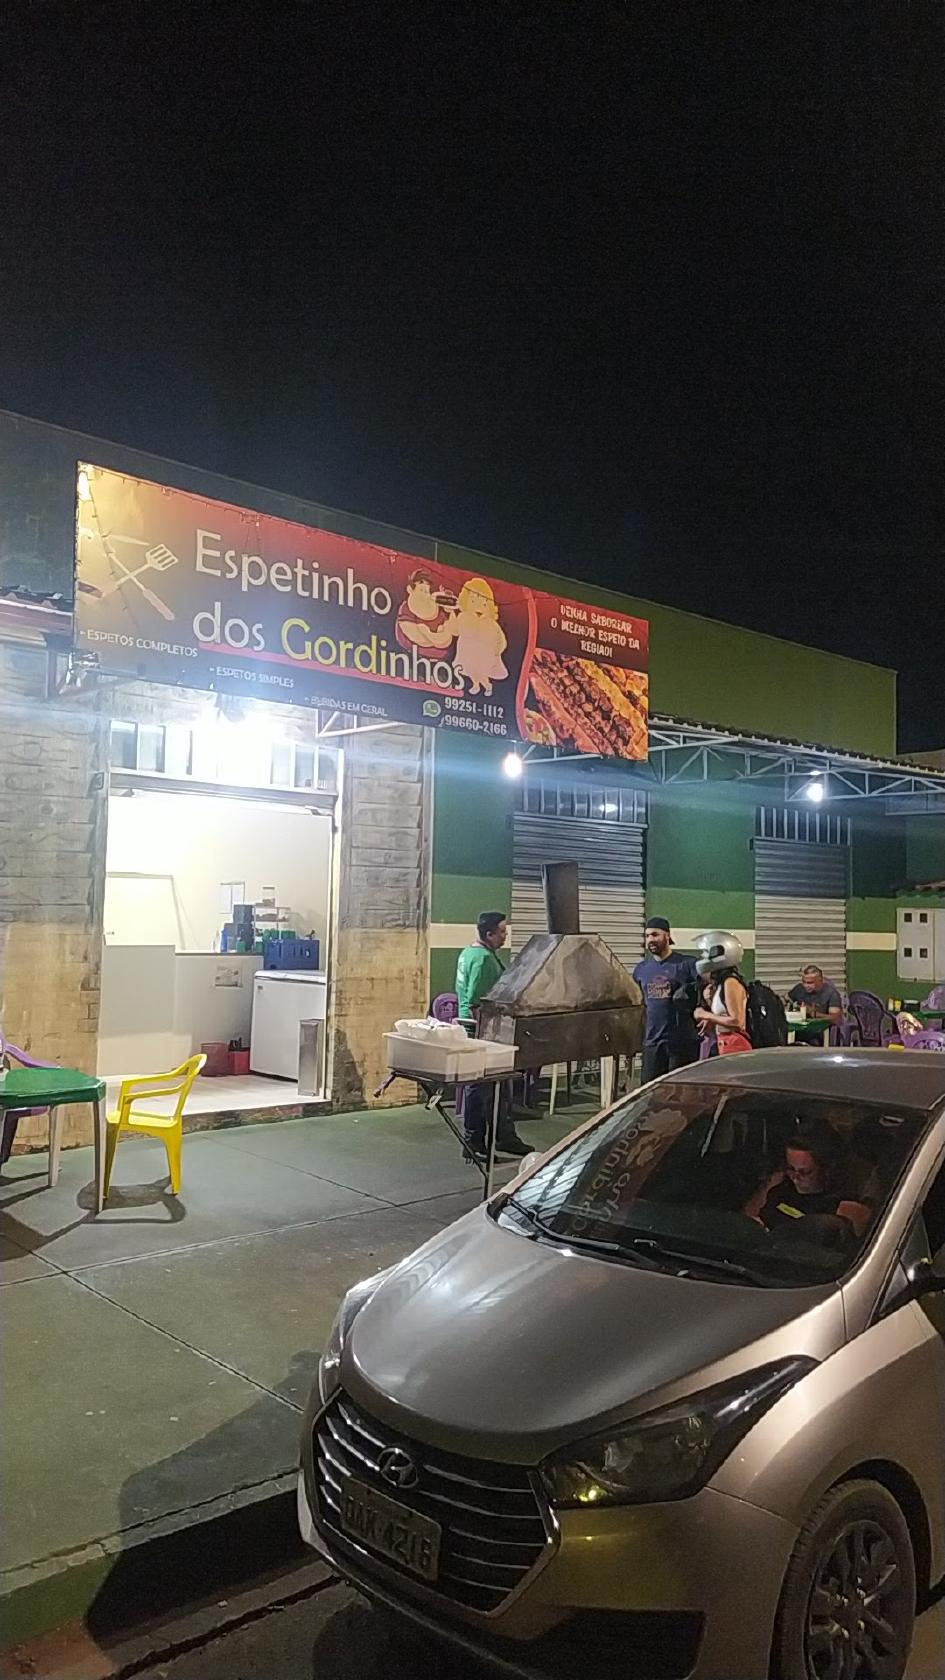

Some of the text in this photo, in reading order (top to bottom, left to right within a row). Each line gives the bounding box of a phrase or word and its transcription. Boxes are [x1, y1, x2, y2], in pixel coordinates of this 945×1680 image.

[195, 528, 392, 615] Espetinho
[560, 604, 633, 634] VENHA SABOREAR
[87, 629, 199, 658] ESPETOS COMPLETOS
[192, 601, 465, 690] dos Gordinhos
[550, 618, 640, 650] O MELHOR ESPETO DA
[216, 666, 294, 688] ESPETOS SIMPLES
[347, 701, 360, 712] EM
[360, 703, 387, 717] GERAL
[444, 697, 504, 719] 99251-1112
